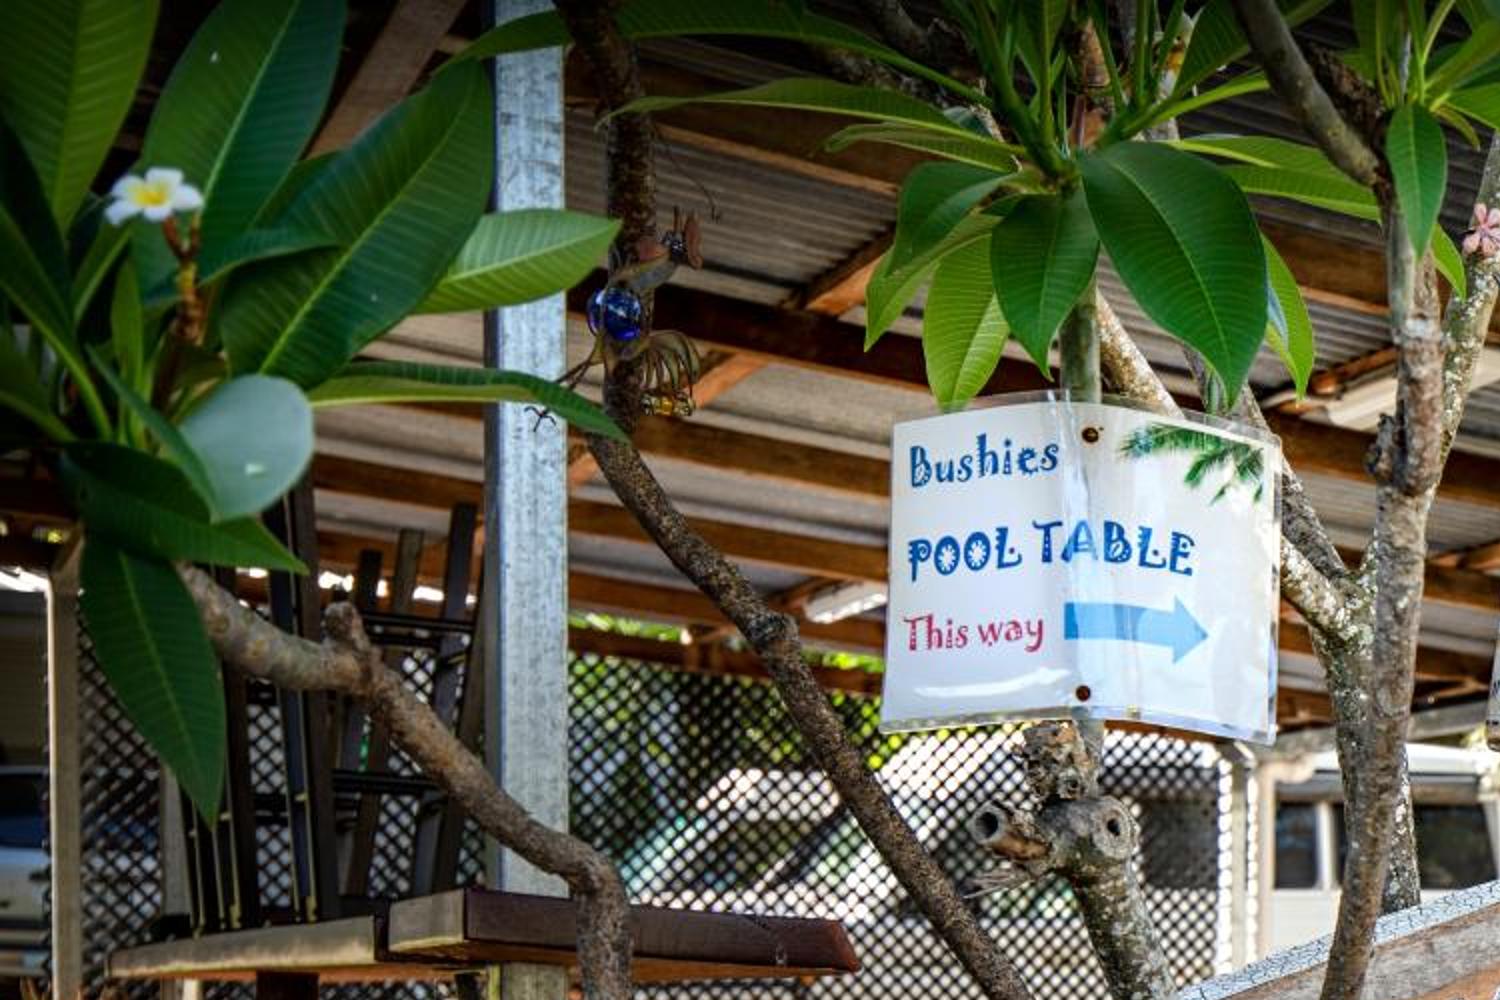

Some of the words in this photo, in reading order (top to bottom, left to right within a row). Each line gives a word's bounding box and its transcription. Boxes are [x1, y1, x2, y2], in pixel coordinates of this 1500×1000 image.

[910, 433, 1060, 488] Bushies
[907, 526, 1023, 582] POOL
[1032, 520, 1196, 577] TABLE
[903, 613, 969, 652] This
[978, 617, 1045, 653] way
